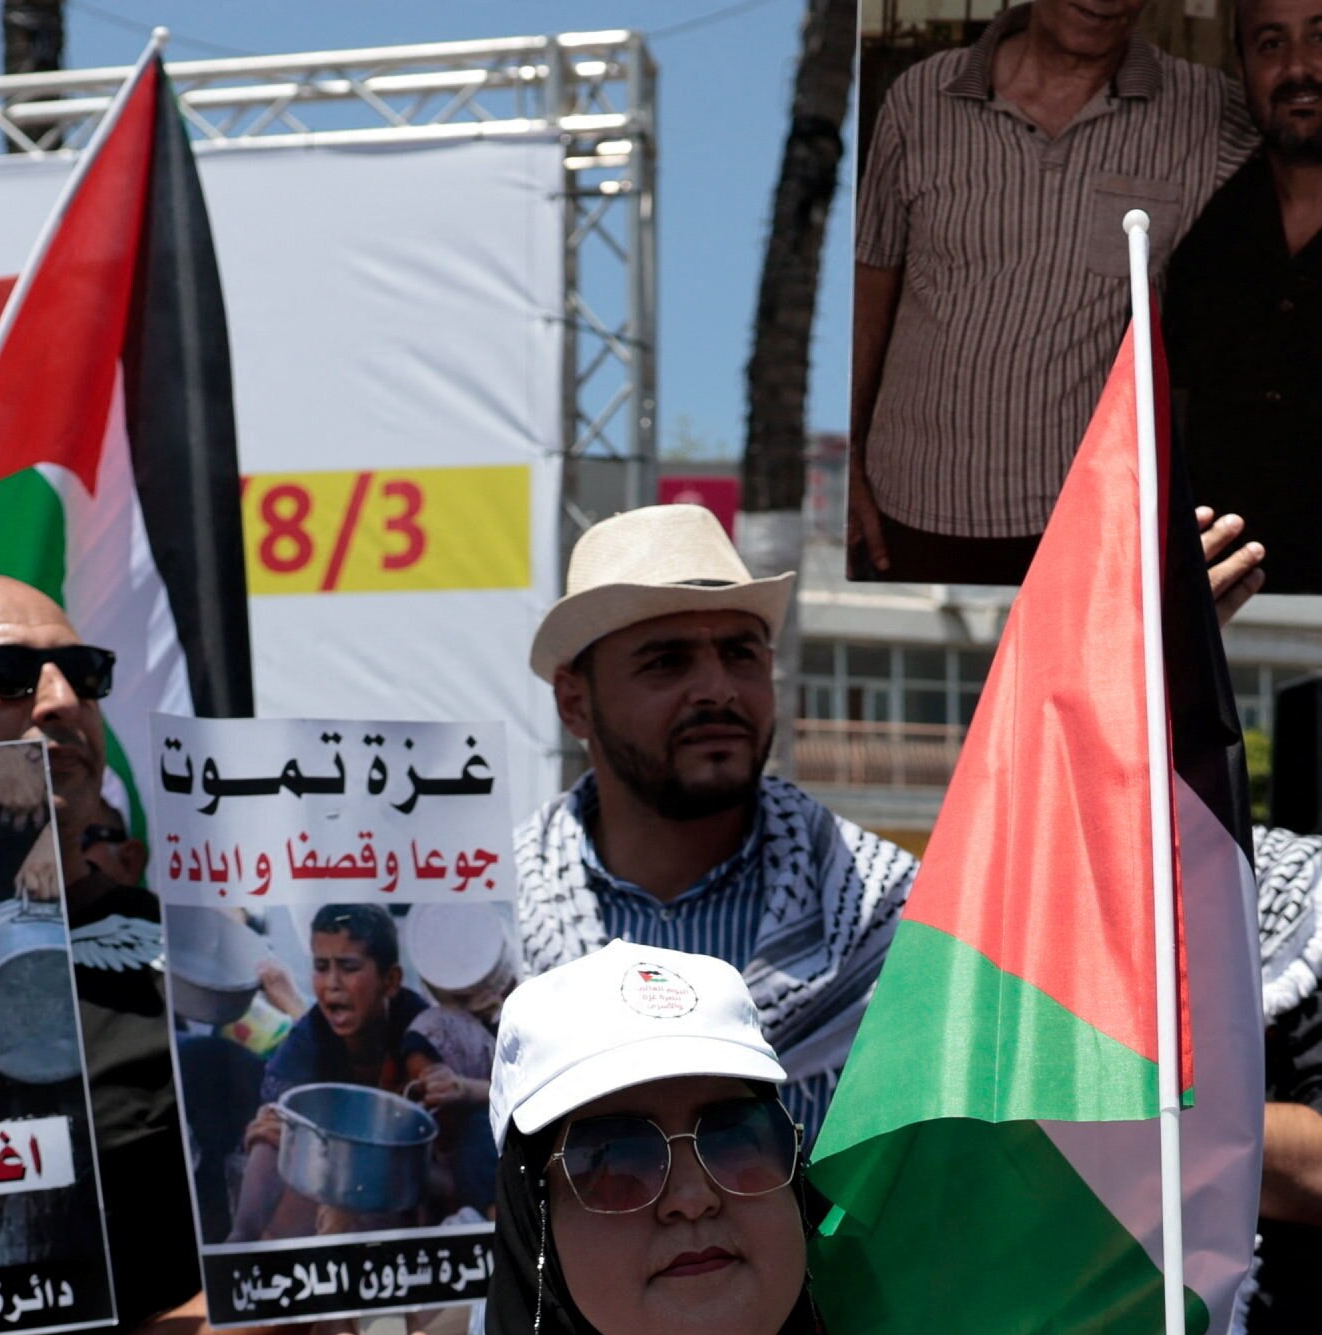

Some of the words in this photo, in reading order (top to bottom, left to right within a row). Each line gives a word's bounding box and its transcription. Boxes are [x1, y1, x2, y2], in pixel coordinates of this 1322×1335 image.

[160, 733, 345, 815] تموت
[364, 735, 493, 814] غزة
[286, 832, 398, 893] وقصفا
[413, 840, 499, 892] جوعا
[235, 1262, 348, 1309] اللاجئين
[361, 1252, 430, 1298] شؤون
[439, 1246, 493, 1290] ائرة
